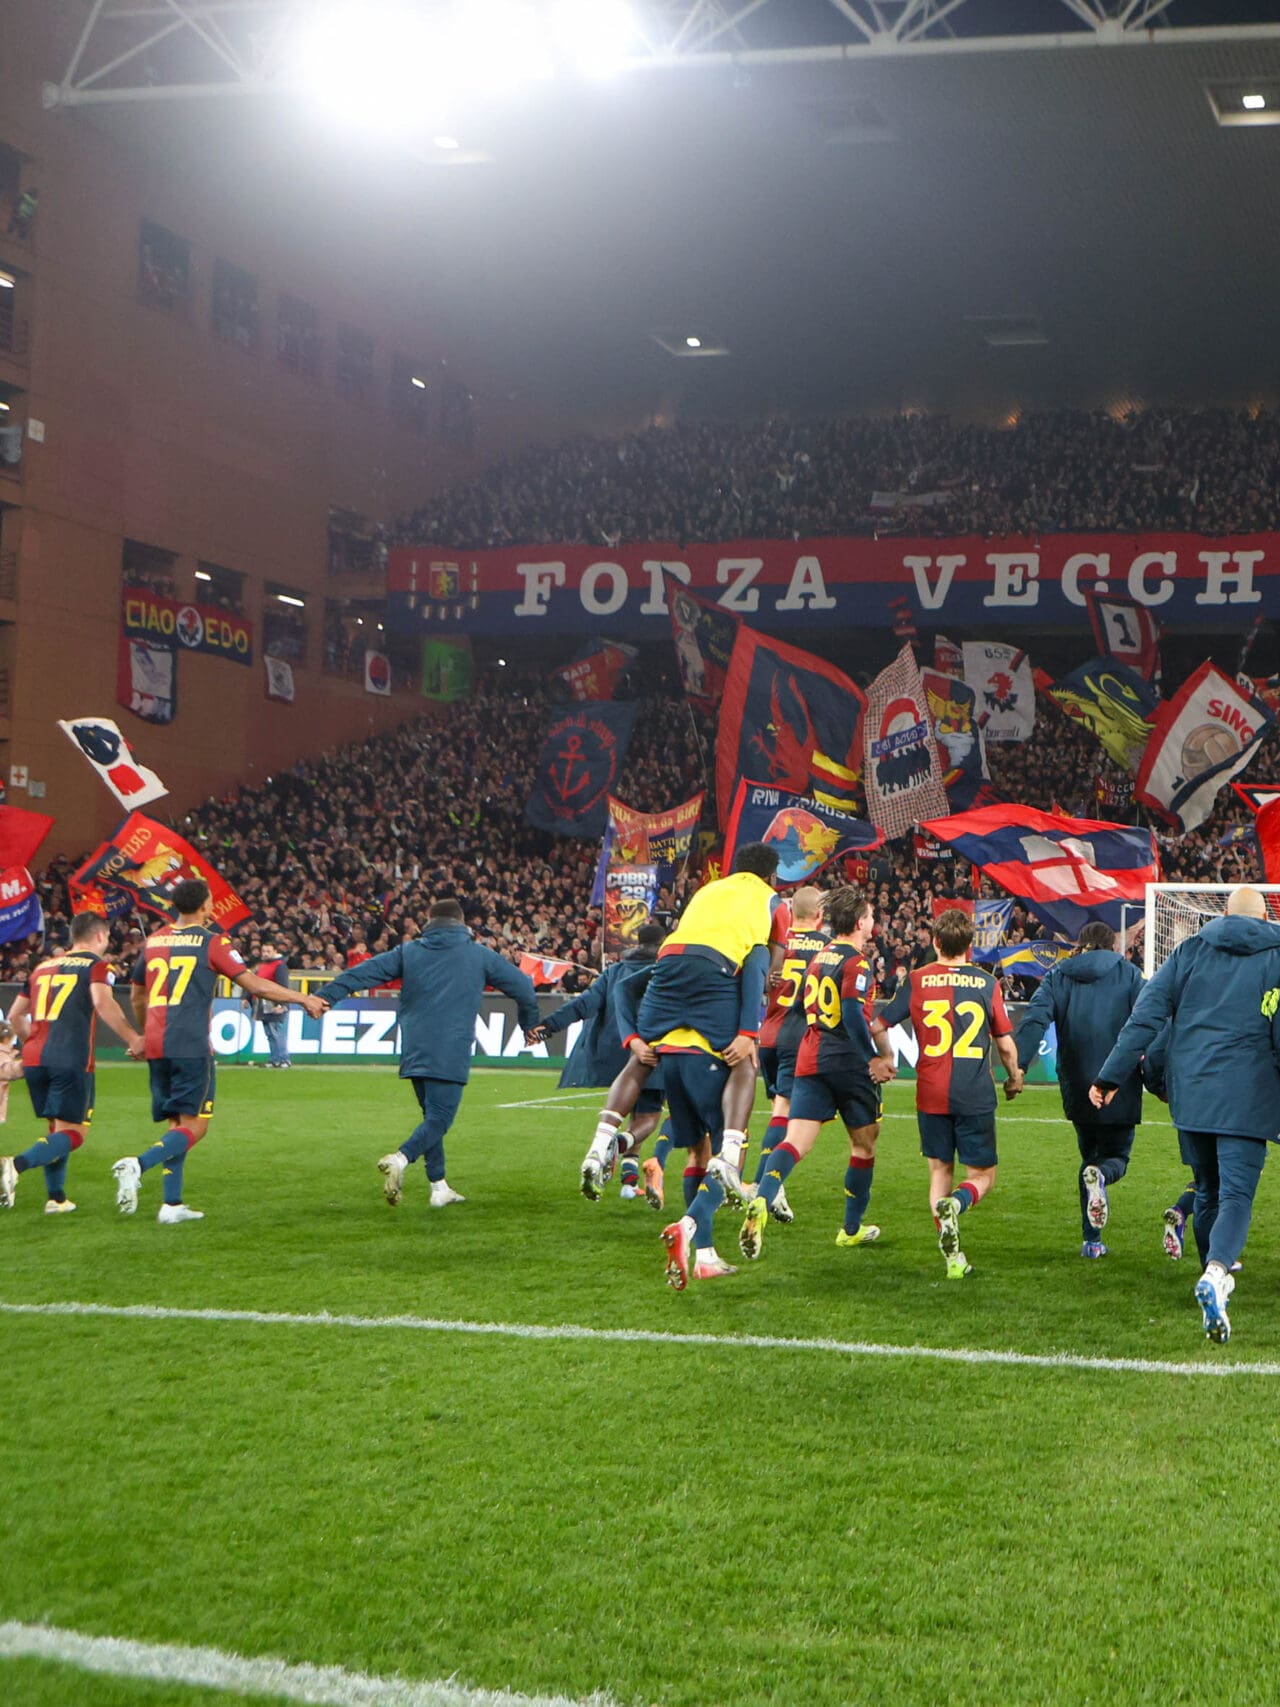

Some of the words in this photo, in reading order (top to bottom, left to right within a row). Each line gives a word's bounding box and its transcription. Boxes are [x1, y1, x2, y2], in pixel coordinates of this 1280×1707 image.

[126, 600, 175, 635] CIAO
[205, 617, 249, 653] EDO
[606, 871, 657, 888] COBRA
[620, 885, 646, 900] 29
[35, 974, 78, 1022] 17
[147, 956, 198, 1008] 27
[777, 959, 807, 1007] 5
[804, 974, 842, 1029] 29
[921, 974, 987, 989] FRENDRUP
[923, 999, 986, 1059] 32
